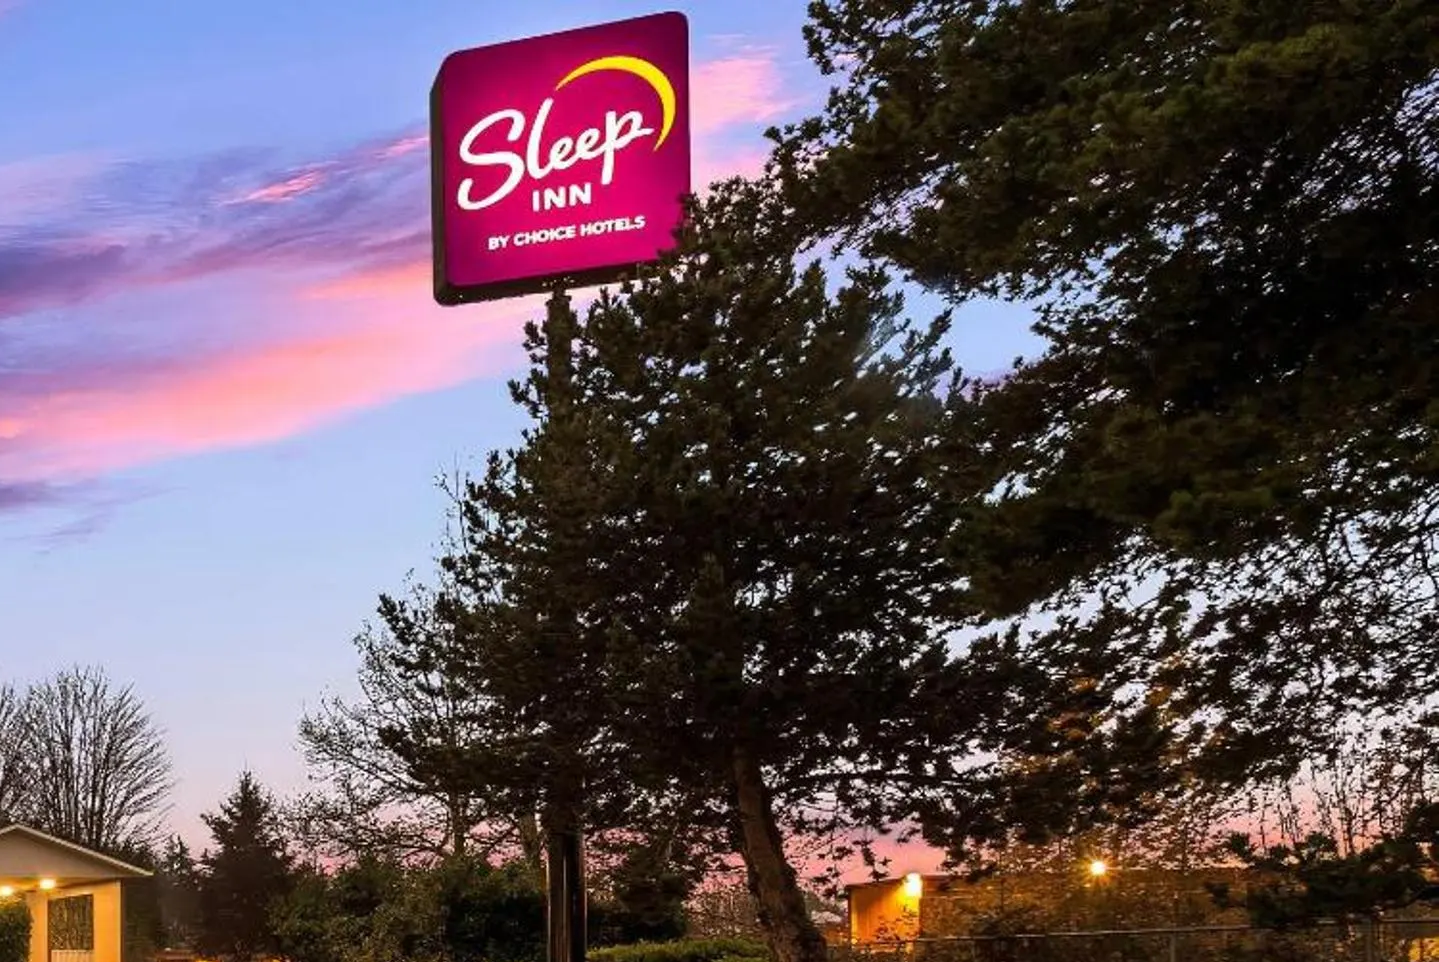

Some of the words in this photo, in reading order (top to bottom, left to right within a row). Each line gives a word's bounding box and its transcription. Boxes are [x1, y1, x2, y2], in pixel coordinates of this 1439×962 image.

[457, 97, 654, 210] Sleep
[532, 182, 592, 212] INN
[488, 235, 509, 250] BY
[513, 225, 576, 246] CHOICE
[580, 215, 646, 237] HOTELS
